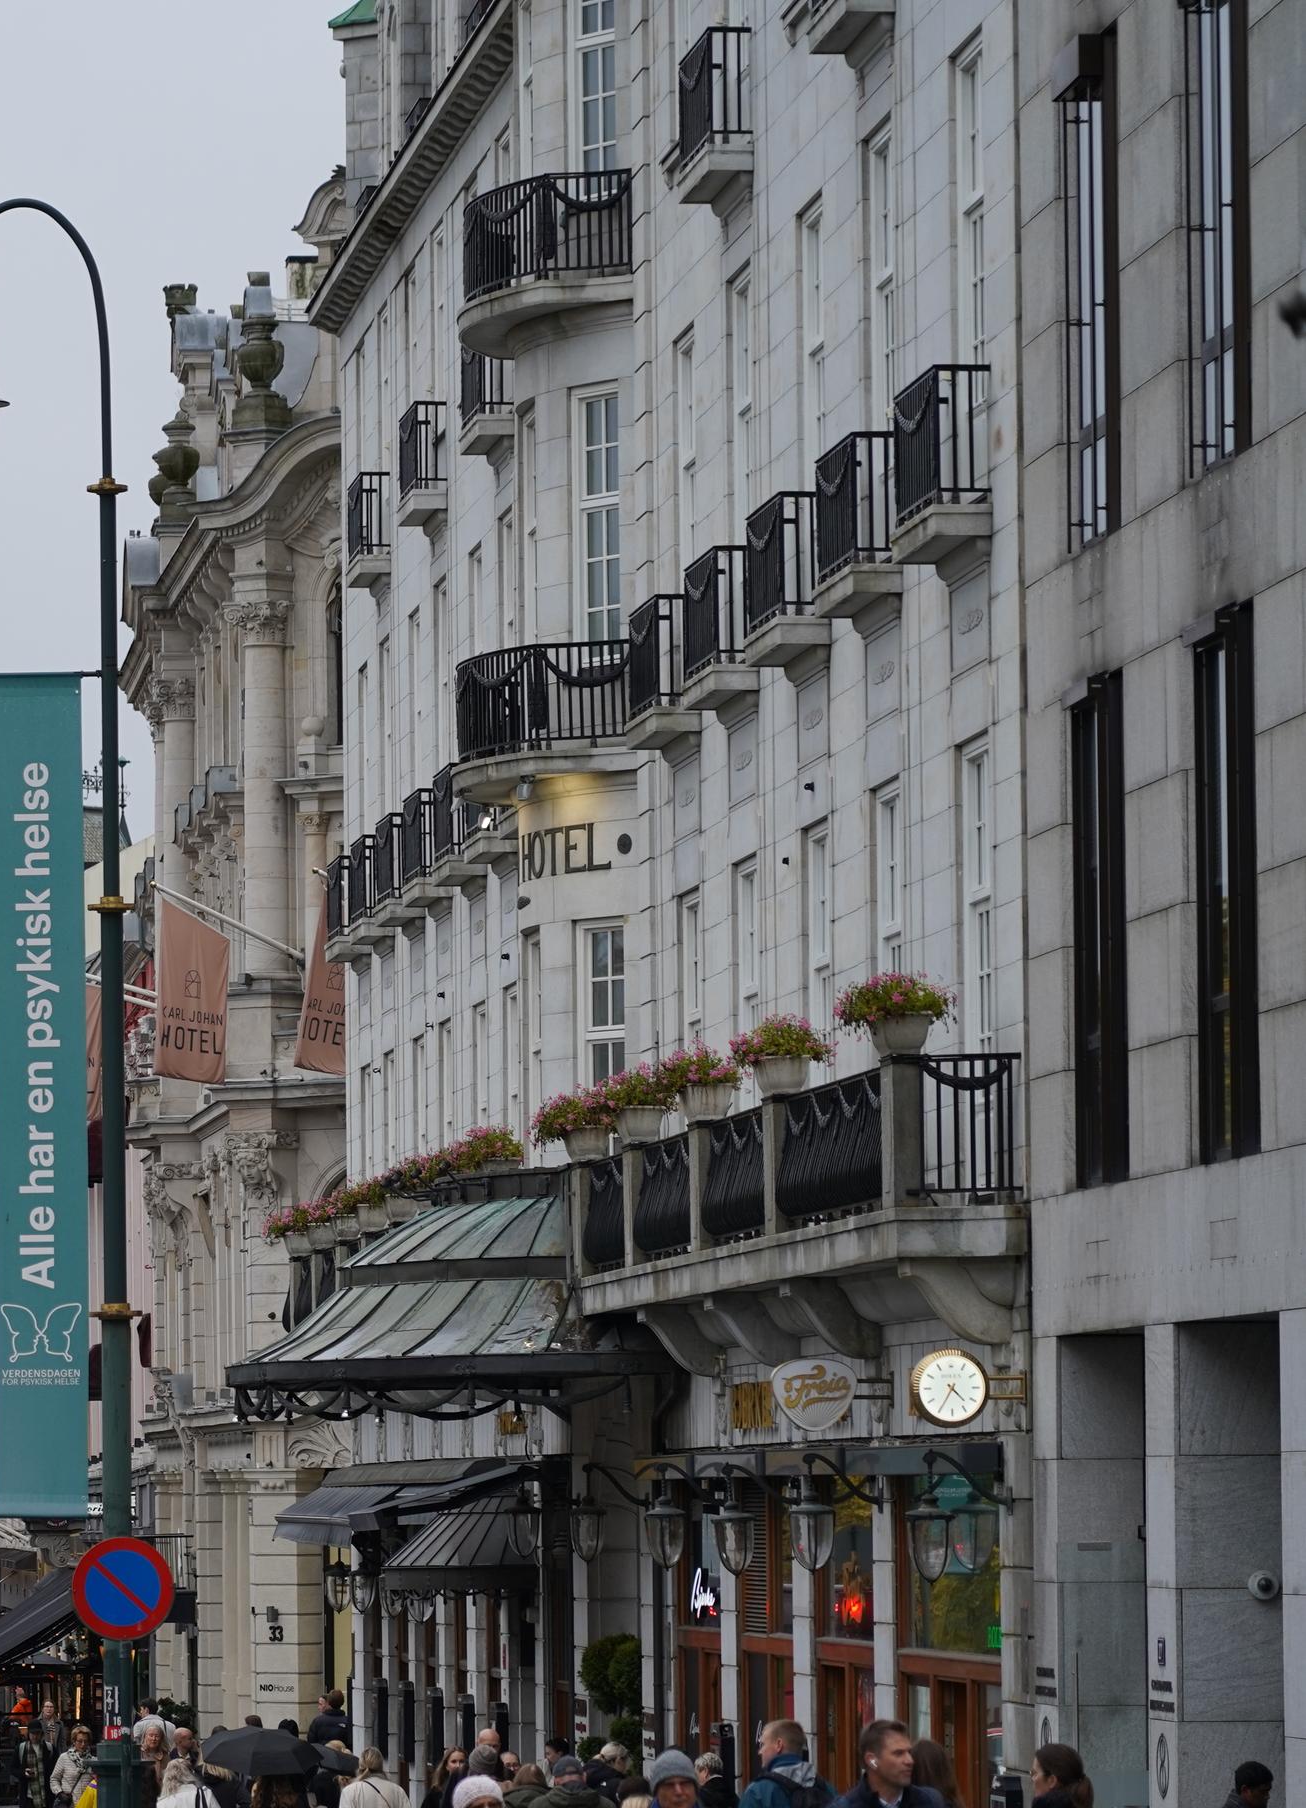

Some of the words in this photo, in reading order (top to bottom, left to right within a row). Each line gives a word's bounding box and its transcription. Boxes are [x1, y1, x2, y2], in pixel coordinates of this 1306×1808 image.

[13, 762, 51, 876] helse
[521, 823, 611, 882] HOTEL
[15, 888, 61, 1048] psykisk
[189, 1010, 223, 1026] JOHAN
[307, 998, 323, 1012] ARL
[161, 1025, 222, 1055] HOTEL
[303, 1016, 345, 1046] OTE
[27, 1061, 54, 1114] en
[19, 1124, 55, 1194] har
[19, 1206, 55, 1289] Alle
[1, 1369, 81, 1378] VERDENSDAGEN
[2, 1378, 19, 1386] FOR
[20, 1378, 53, 1386] PSYKISK
[54, 1378, 80, 1386] HELSE
[268, 1625, 284, 1642] 33
[259, 1684, 274, 1693] NIO
[274, 1685, 295, 1693] House
